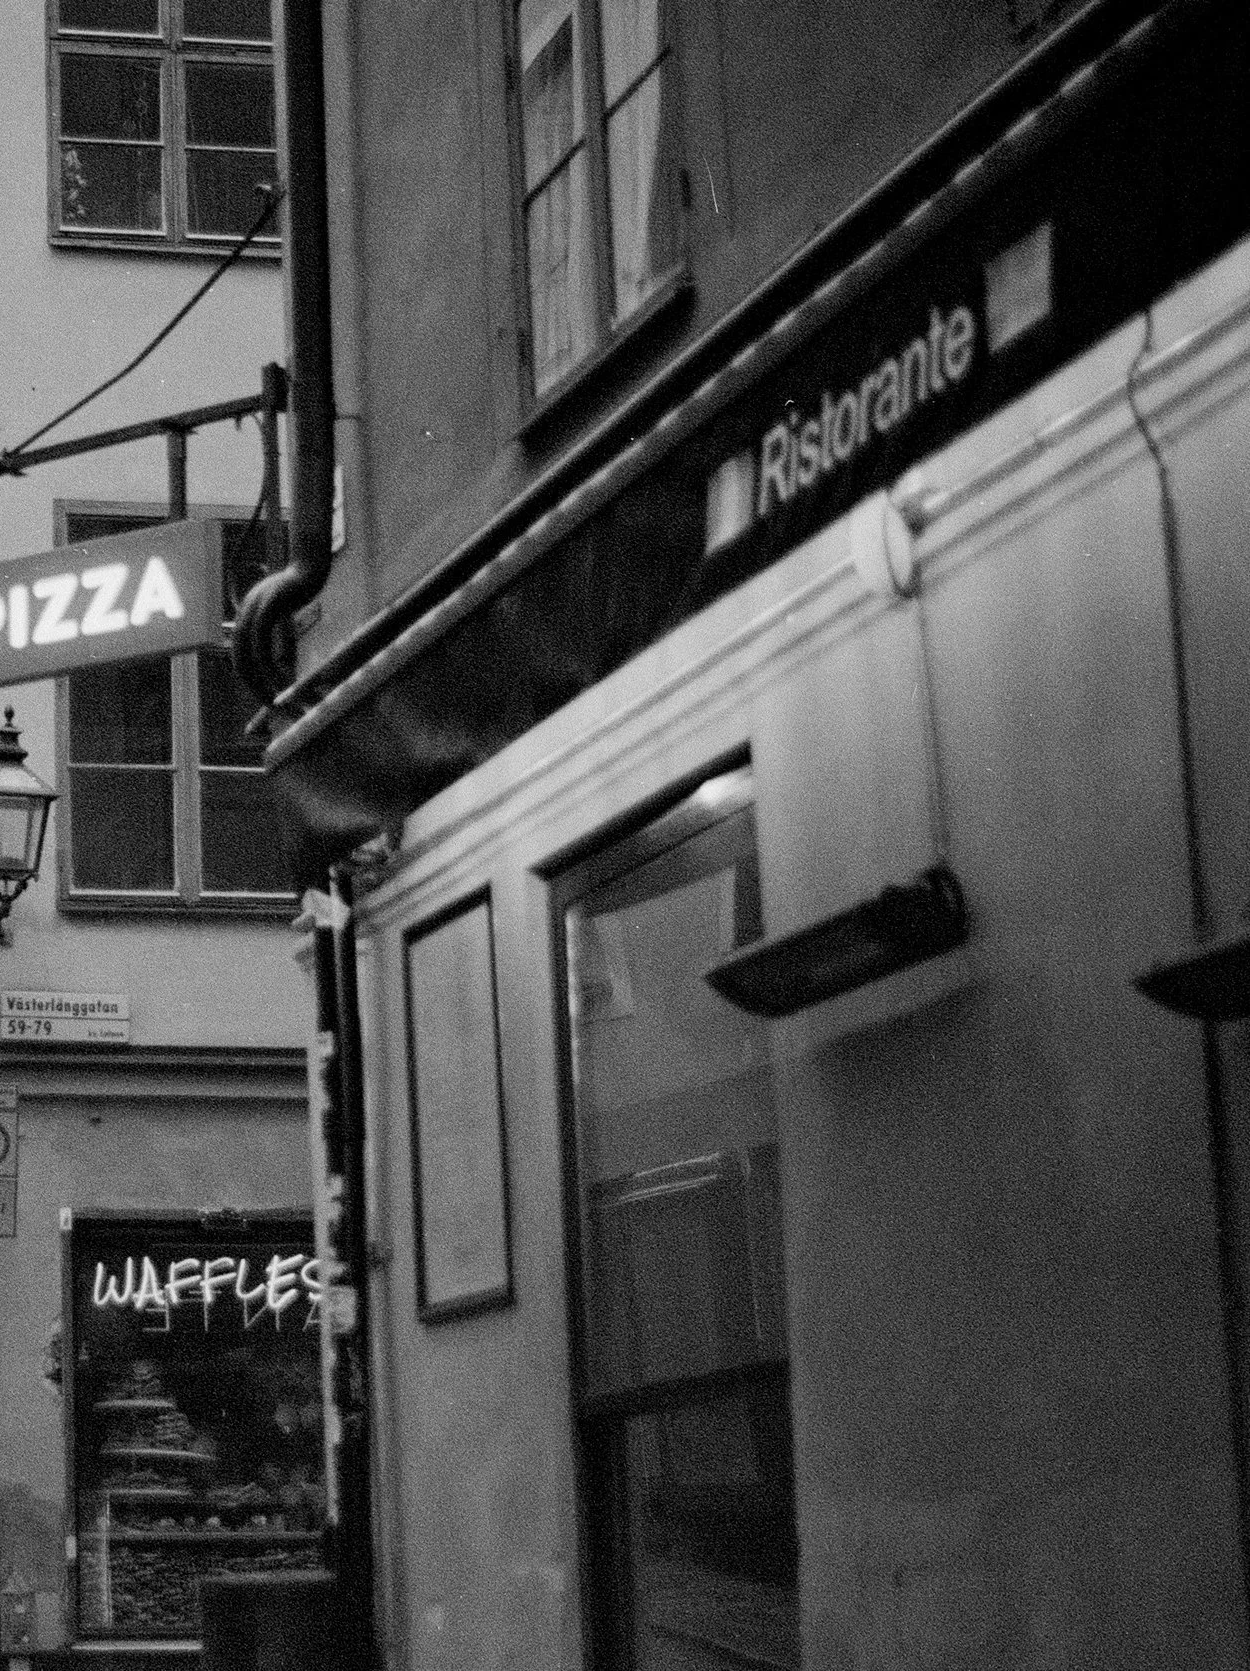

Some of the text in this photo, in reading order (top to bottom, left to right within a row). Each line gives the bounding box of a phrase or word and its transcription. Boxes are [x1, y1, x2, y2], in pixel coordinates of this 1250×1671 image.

[758, 305, 974, 515] Ristorante
[7, 996, 119, 1017] Västerlånggatan
[8, 1019, 53, 1036] 59-79
[94, 1253, 325, 1310] WAFFLES
